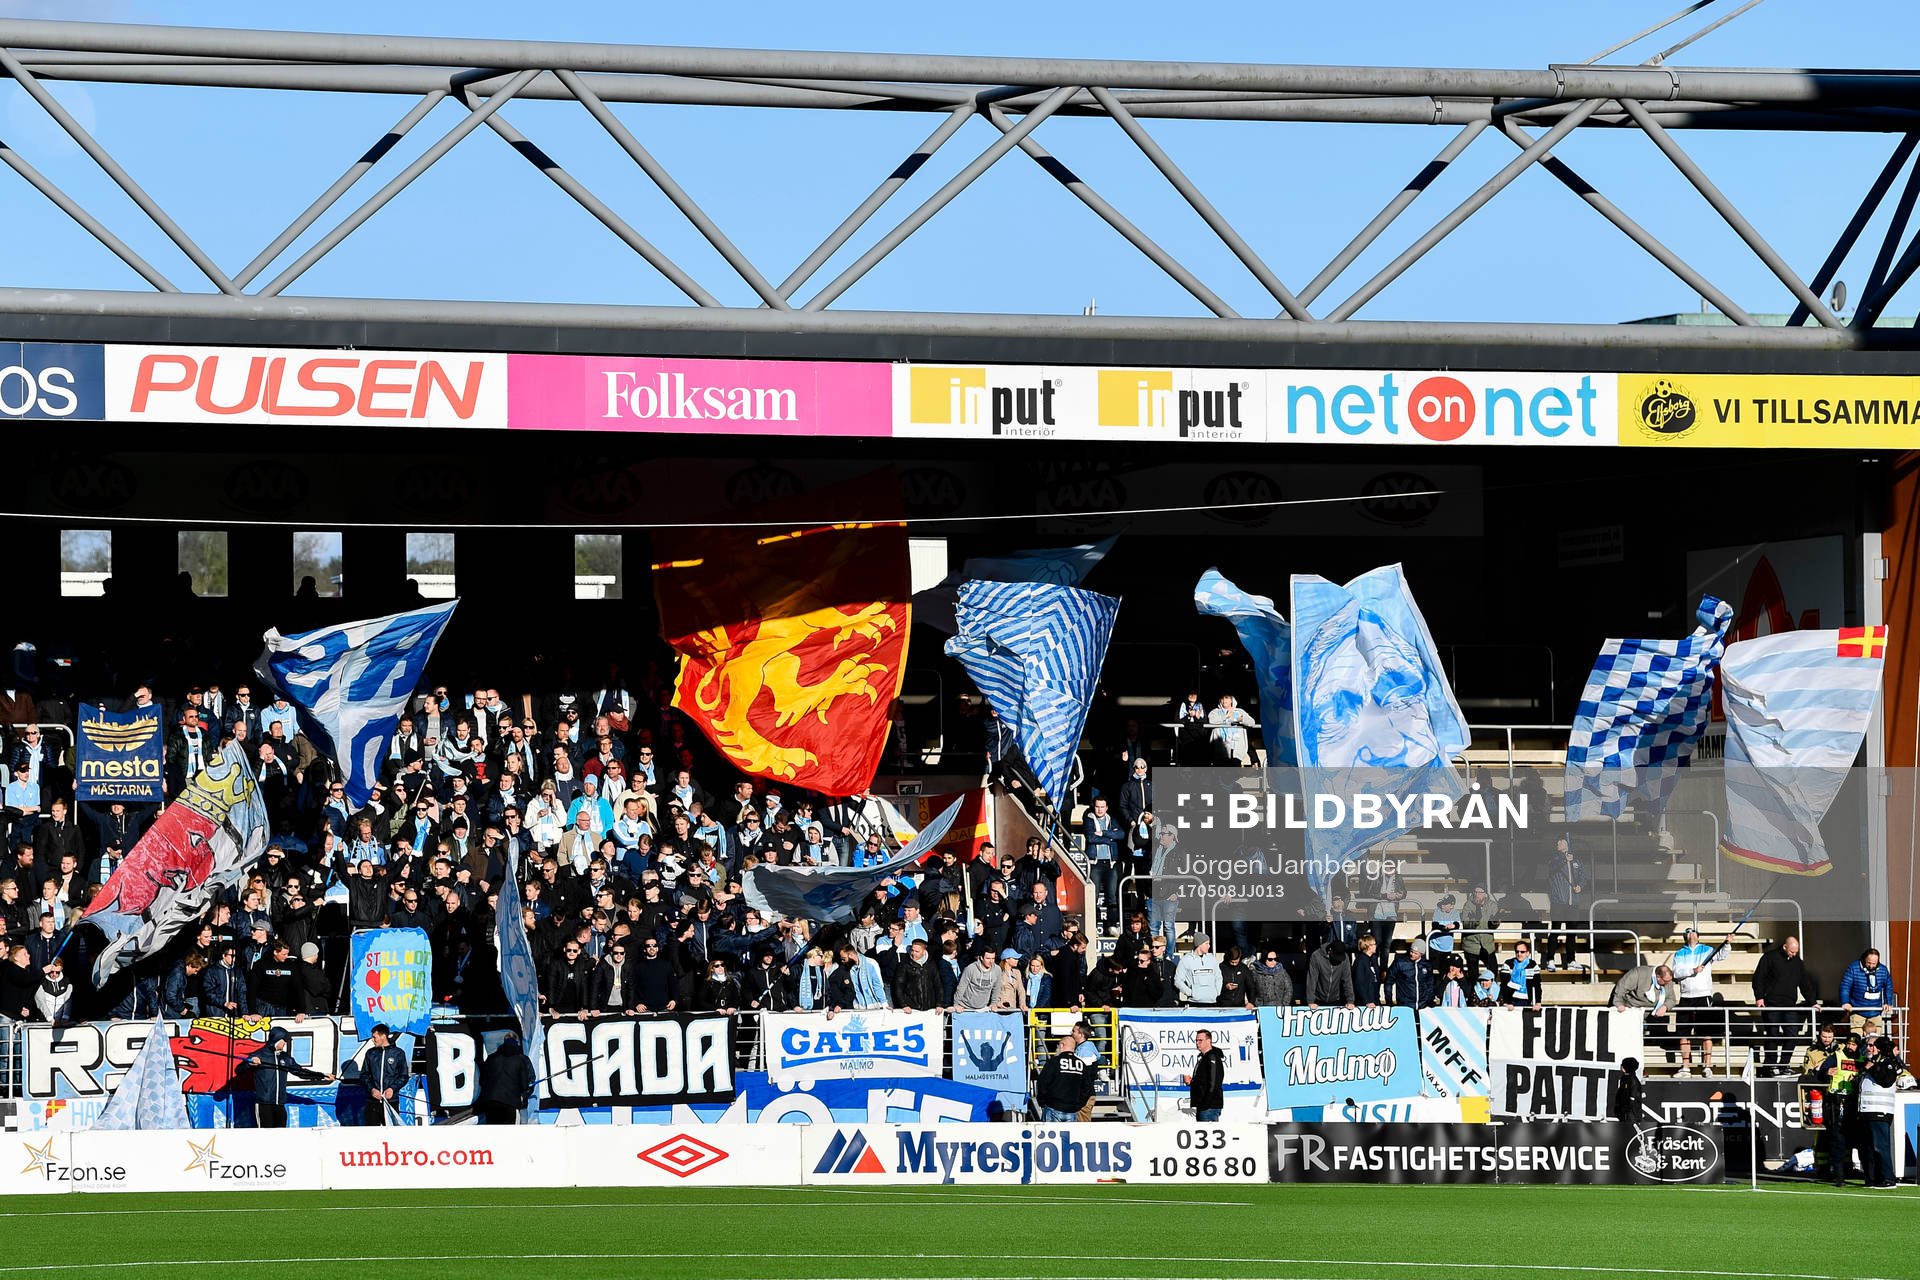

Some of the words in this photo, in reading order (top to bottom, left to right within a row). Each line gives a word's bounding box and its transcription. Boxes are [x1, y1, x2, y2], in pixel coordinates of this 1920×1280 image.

[130, 354, 484, 419] PULSEN
[602, 371, 798, 421] Folksam
[1287, 373, 1398, 435] net
[1417, 396, 1467, 423] on
[1485, 375, 1596, 437] net
[1713, 399, 1740, 423] VI
[1006, 427, 1056, 436] interiör
[1192, 430, 1242, 439] interiör
[82, 756, 159, 777] mesta
[91, 783, 152, 796] MÄSTARNA
[366, 951, 399, 968] STILL
[404, 950, 430, 966] NOT
[1160, 1030, 1230, 1044] FRAKON
[1522, 1007, 1615, 1062] FULL
[436, 1016, 734, 1108] BGADA
[1059, 1058, 1084, 1072] SLO
[1176, 1129, 1240, 1149] 033-
[1647, 1135, 1705, 1151] Fräscht
[339, 1141, 494, 1167] umbro.com
[896, 1129, 1132, 1184] Myresjöhus
[1274, 1134, 1331, 1172] FR
[1333, 1145, 1610, 1172] FASTIGHETSSERVICE
[1672, 1156, 1707, 1170] Rent
[46, 1162, 126, 1181] Fzon.se
[209, 1160, 287, 1179] Fzon.se
[1150, 1157, 1178, 1177] 10
[1185, 1157, 1217, 1177] 86
[1224, 1156, 1256, 1176] 80
